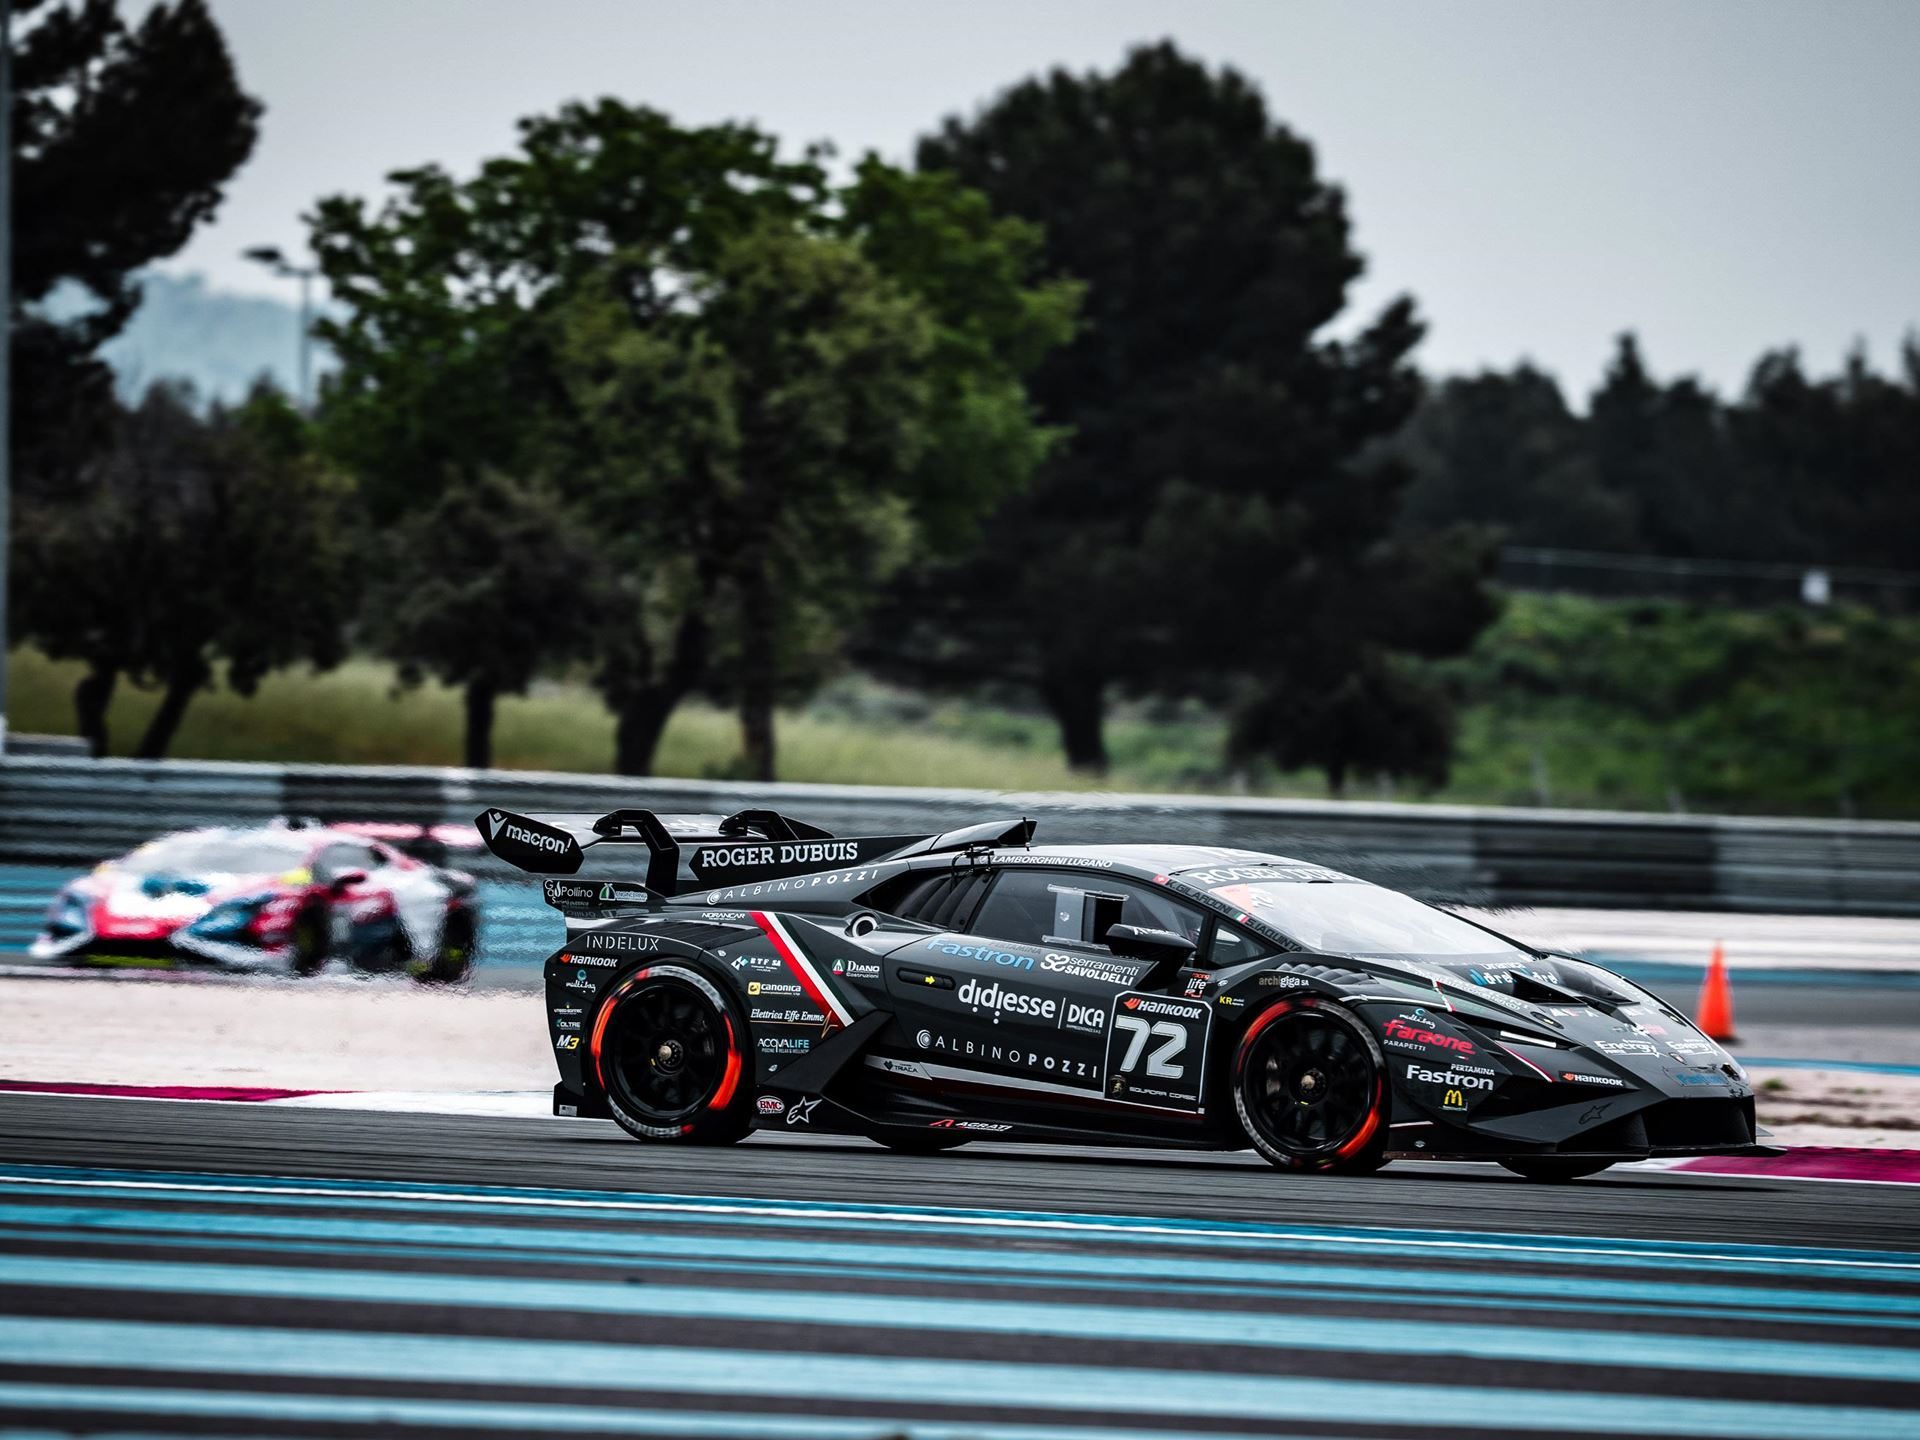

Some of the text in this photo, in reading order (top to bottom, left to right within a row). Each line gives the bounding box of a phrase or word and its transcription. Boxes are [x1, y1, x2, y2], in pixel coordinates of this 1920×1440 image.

[702, 842, 858, 867] ROGER DUBUIS
[992, 855, 1113, 868] LAMBORGHINI LUGANO
[561, 882, 593, 898] Pollino
[586, 935, 660, 951] INDELUX
[927, 938, 1035, 970] Fastron
[1069, 957, 1140, 976] serramenti
[1064, 965, 1134, 986] SAVOLDELLI
[1186, 977, 1207, 990] life
[1259, 975, 1300, 989] archigiga
[761, 983, 801, 992] canonica
[958, 978, 1056, 1025] didiesse
[1219, 995, 1233, 1006] KR
[750, 1008, 825, 1023] Elettrica Effe Emme
[1067, 1004, 1105, 1028] DICA
[1382, 1019, 1476, 1055] faraone
[1115, 1014, 1187, 1079] 72
[1383, 1039, 1426, 1052] PARAPETTI
[1406, 1064, 1494, 1091] Fastron
[1450, 1063, 1495, 1076] PERTAMINA
[759, 1100, 782, 1110] BMC
